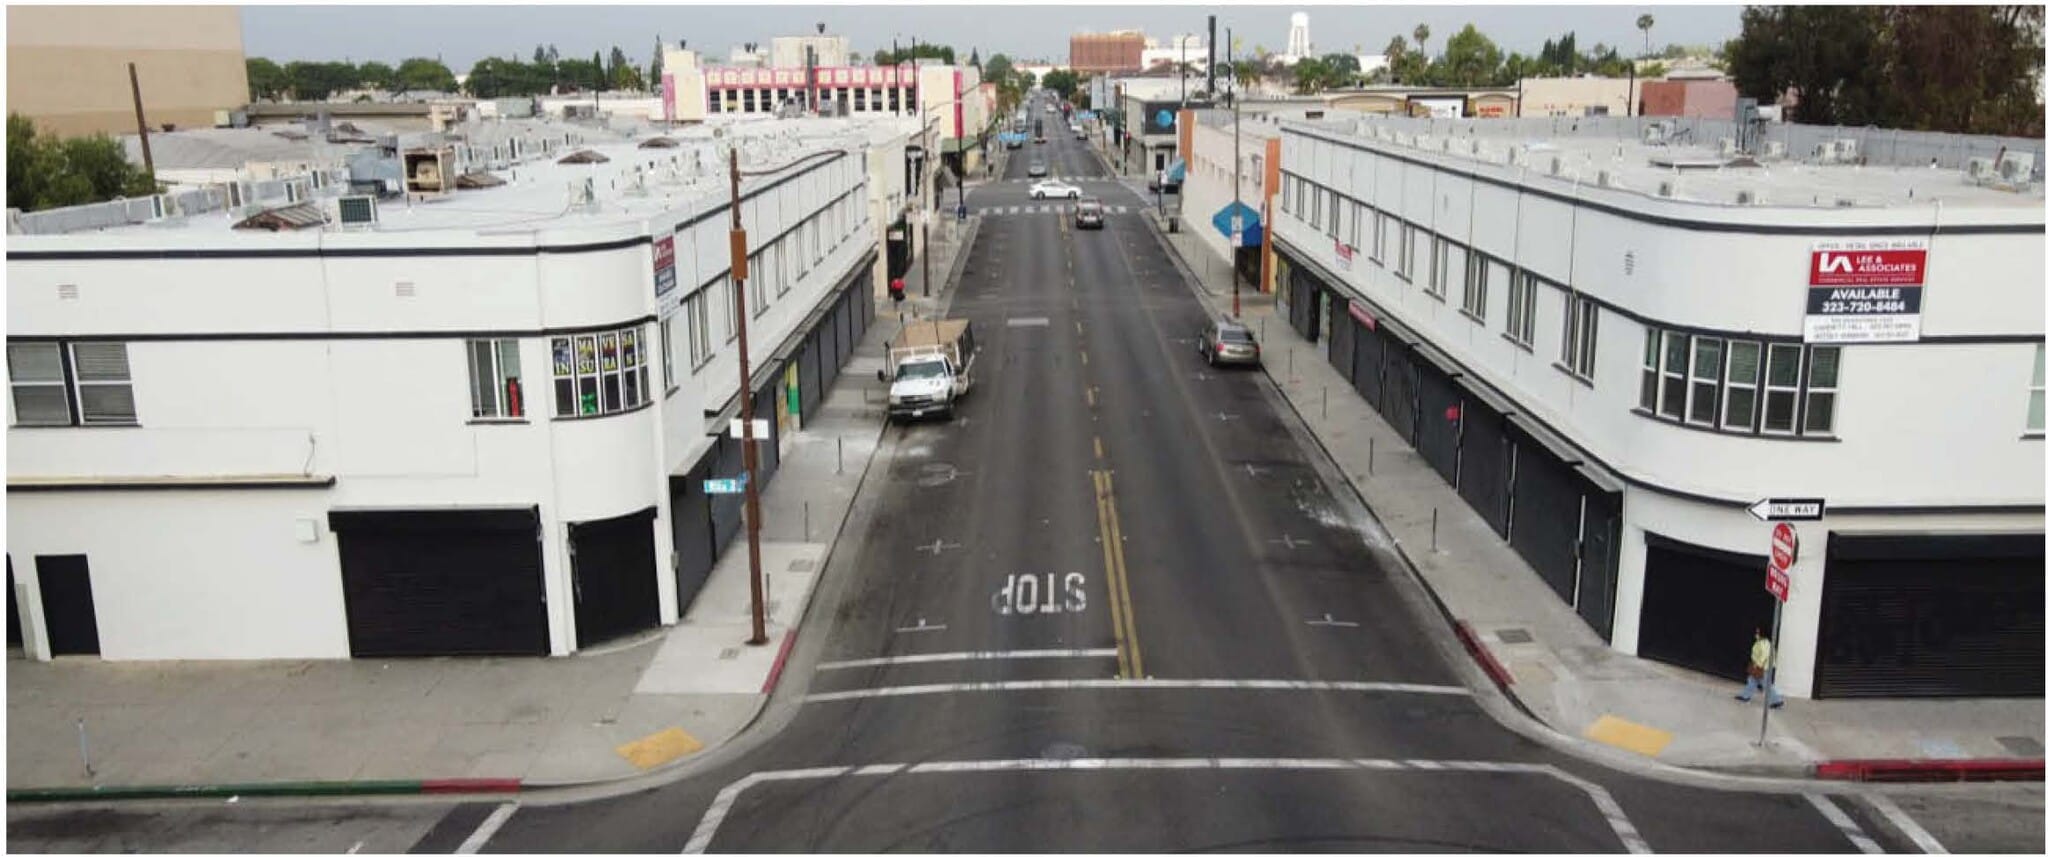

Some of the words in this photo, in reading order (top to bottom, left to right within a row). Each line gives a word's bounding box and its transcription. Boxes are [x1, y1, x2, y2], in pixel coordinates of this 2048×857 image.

[1856, 256, 1874, 265] LEE
[1875, 255, 1883, 264] &
[1858, 264, 1916, 272] ASSOCIATES
[1830, 288, 1901, 300] AVAILABLE
[1822, 300, 1905, 312] 323-720-8484
[555, 361, 570, 374] IN
[1769, 504, 1790, 514] ONE
[1794, 504, 1816, 514] WAY
[991, 571, 1087, 615] STOP
